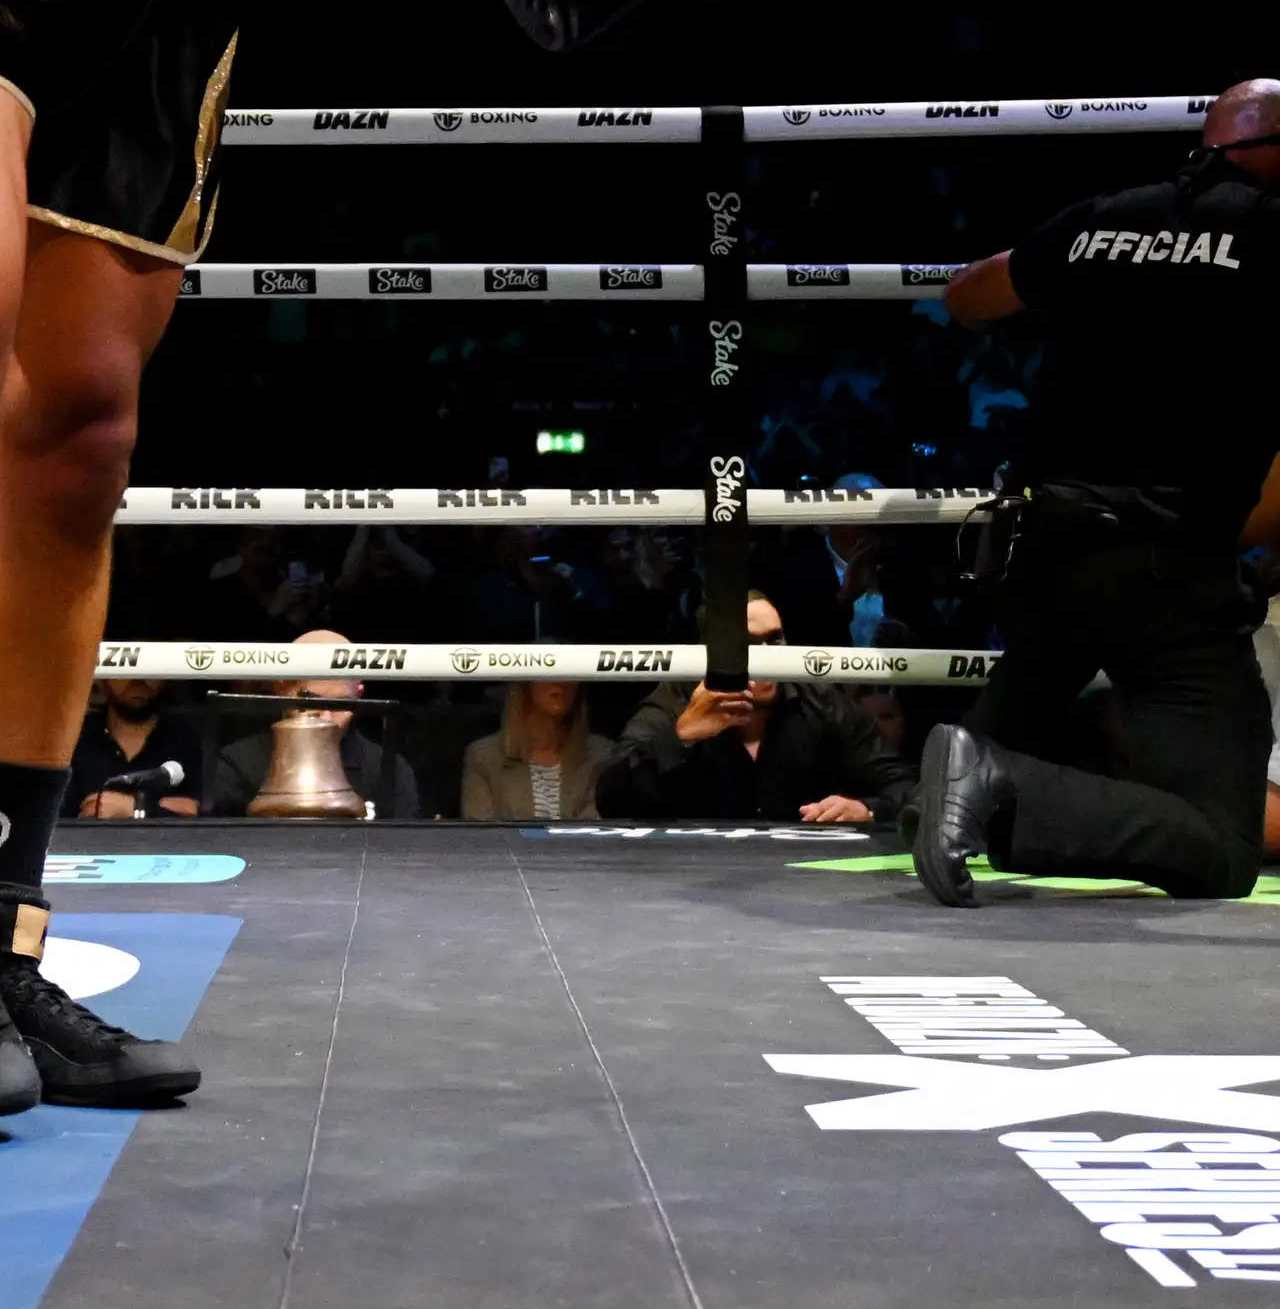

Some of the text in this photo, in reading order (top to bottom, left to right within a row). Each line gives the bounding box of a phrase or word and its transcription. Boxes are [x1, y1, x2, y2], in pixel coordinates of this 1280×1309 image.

[313, 111, 389, 130] DAZN
[470, 111, 538, 125] BOXING
[578, 109, 653, 126] DAZN
[706, 191, 741, 255] Stake
[1069, 230, 1240, 269] OFFICIAL
[261, 265, 655, 293] Stake Stake Stake Stake
[794, 264, 841, 282] Stake
[709, 320, 742, 386] Stake
[710, 456, 744, 522] Stake
[222, 649, 290, 664] BOXING
[330, 648, 407, 669] DAZN
[488, 652, 556, 668] BOXING
[597, 649, 673, 672] DAZN
[841, 655, 909, 672] BOXING
[947, 655, 1002, 679] DAZ
